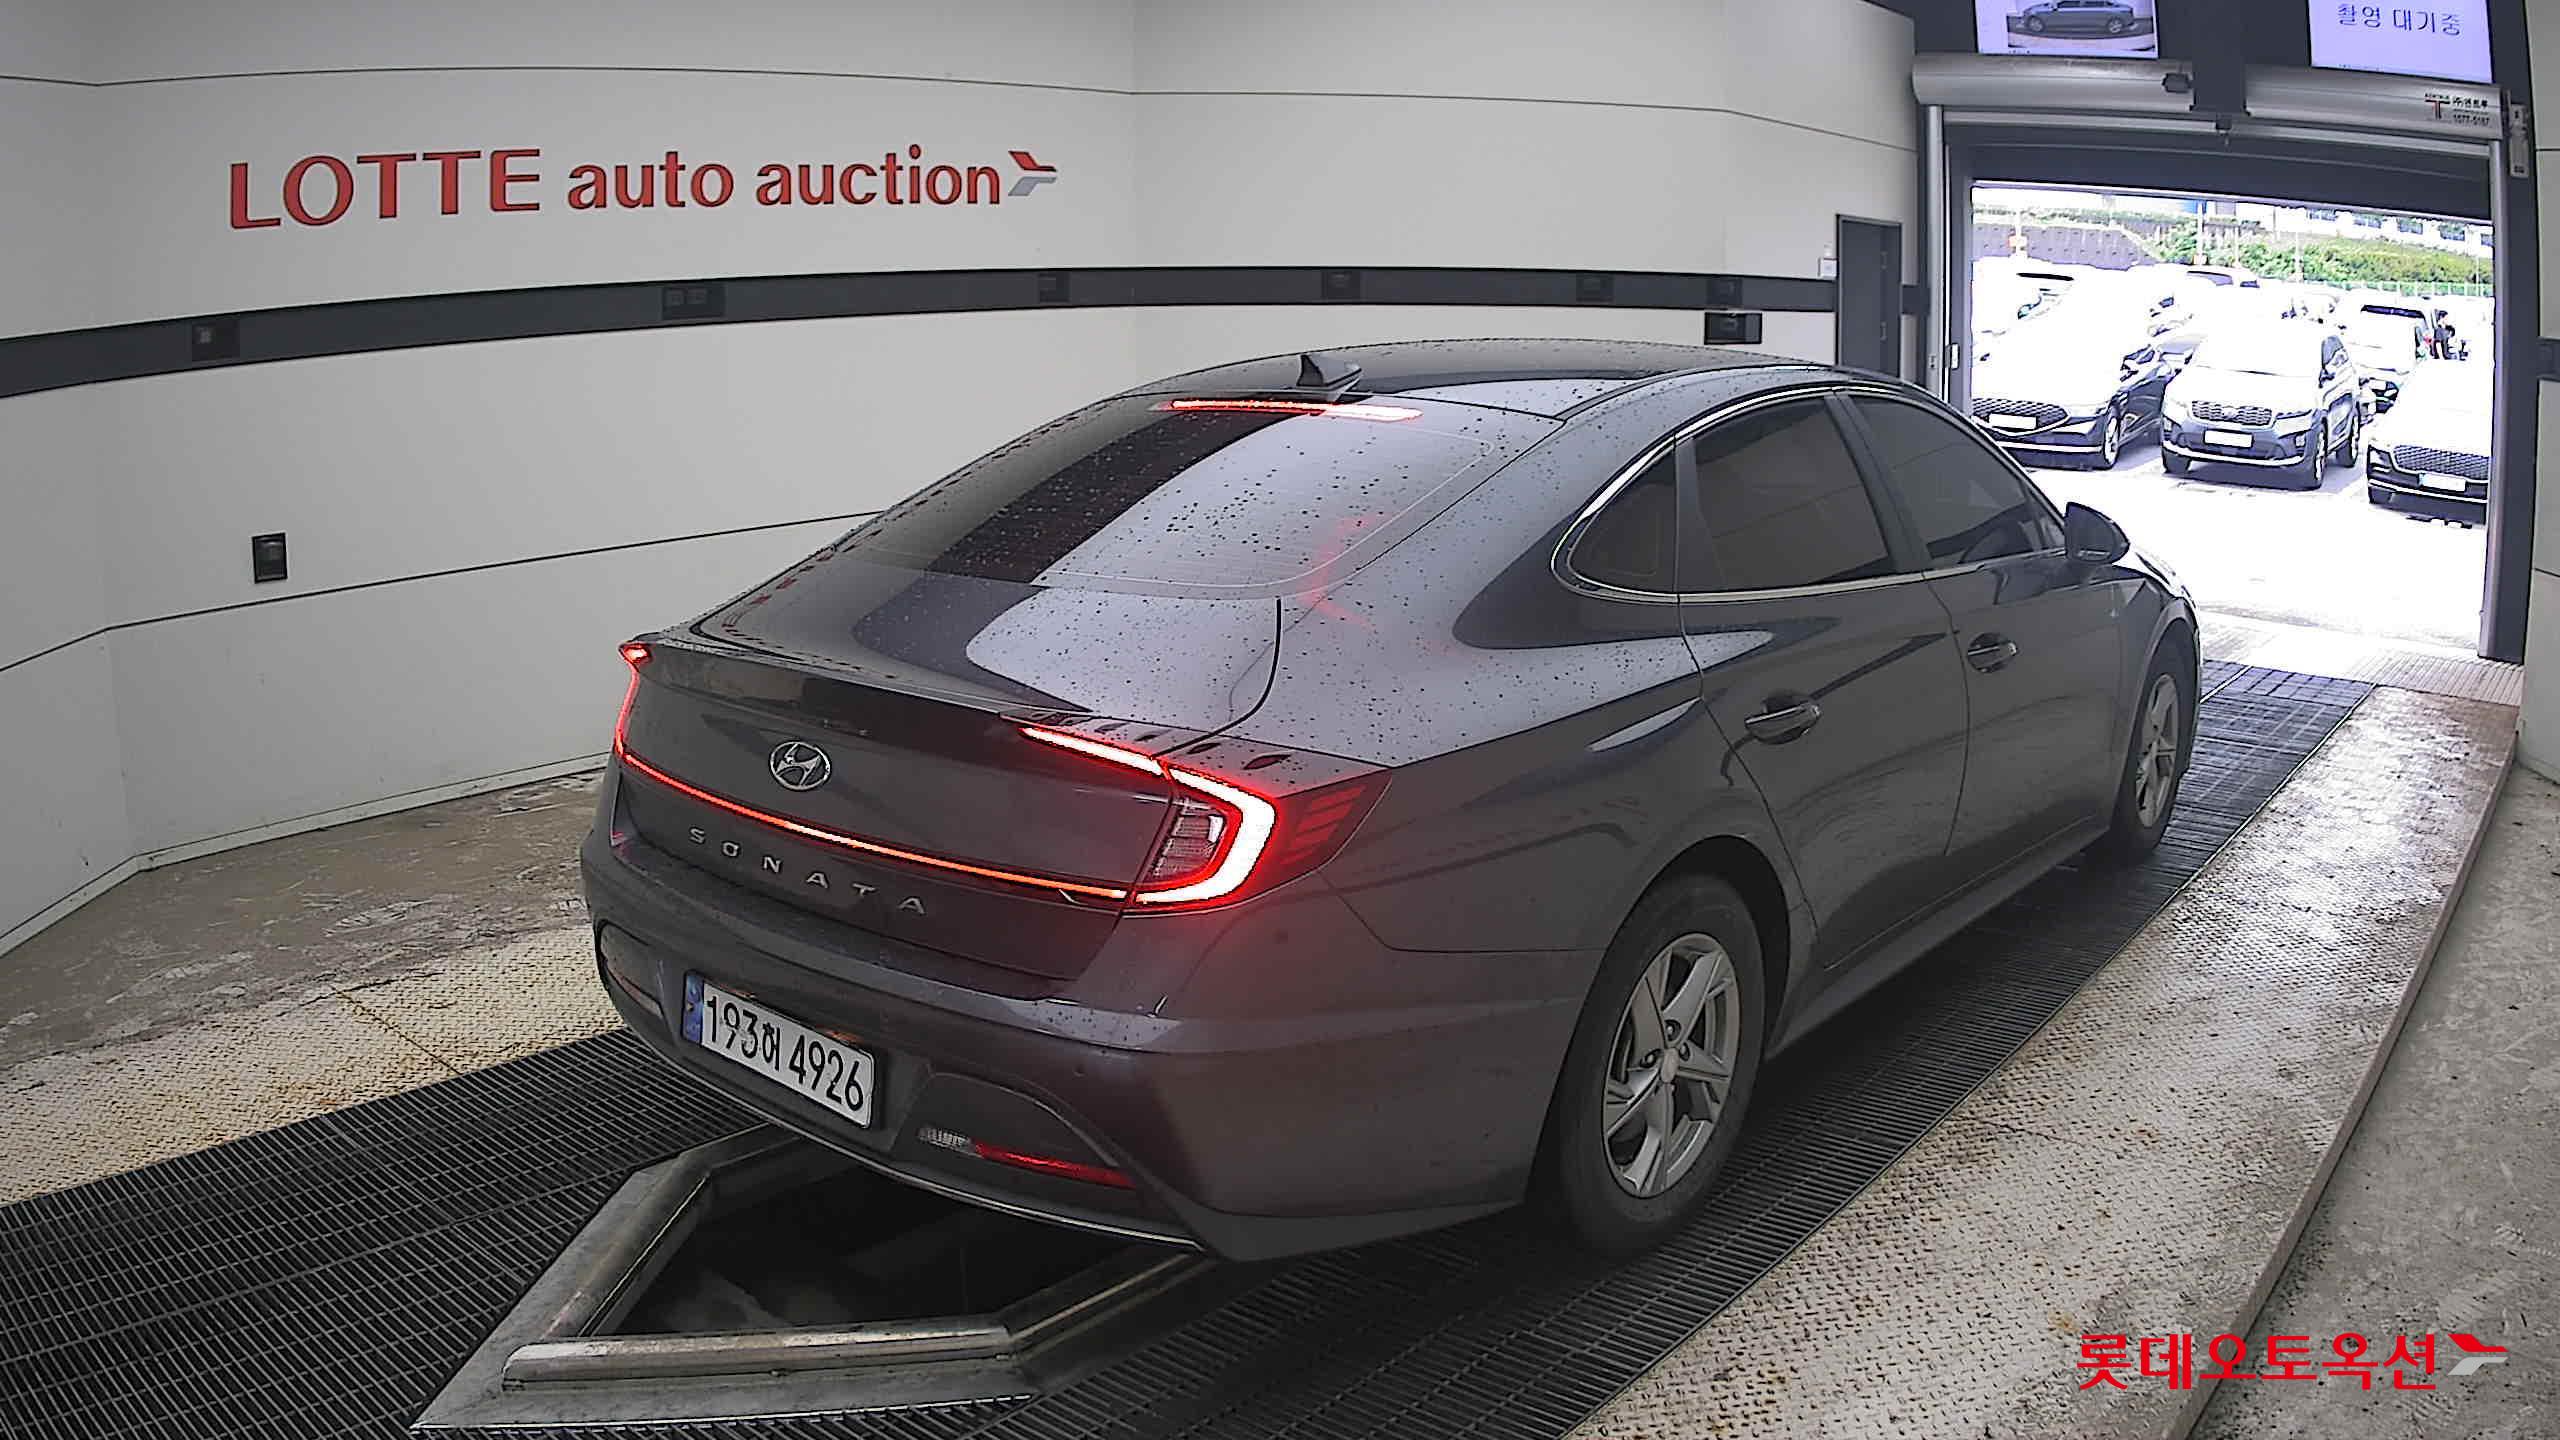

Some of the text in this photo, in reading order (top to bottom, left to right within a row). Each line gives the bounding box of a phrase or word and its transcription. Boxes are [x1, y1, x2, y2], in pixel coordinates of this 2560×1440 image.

[2338, 3, 2460, 36] 촬영 대기중
[229, 144, 1002, 230] LOTTE auto auction
[689, 826, 927, 916] SONATA
[706, 996, 865, 1112] 193허 4926
